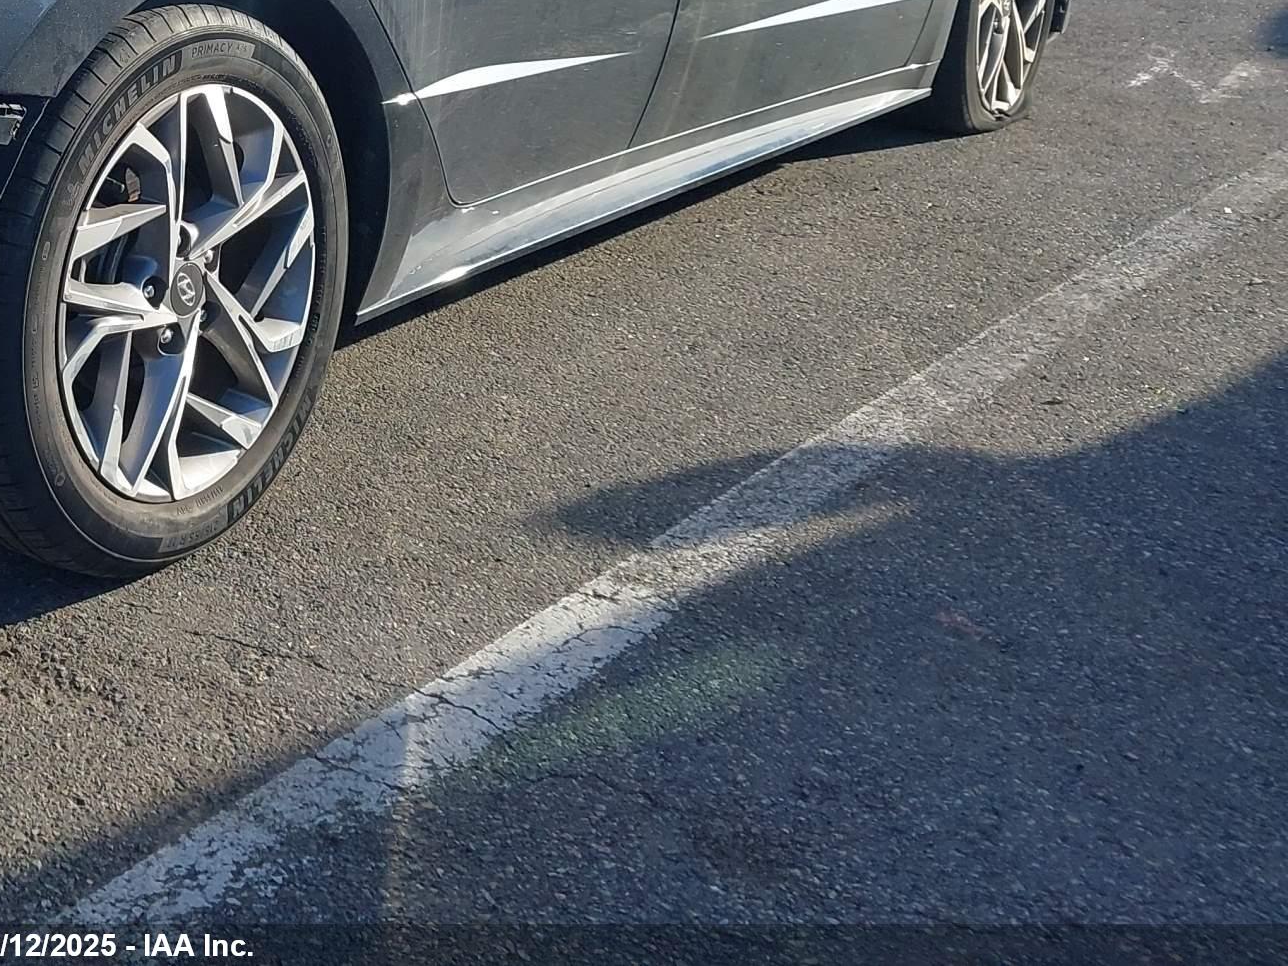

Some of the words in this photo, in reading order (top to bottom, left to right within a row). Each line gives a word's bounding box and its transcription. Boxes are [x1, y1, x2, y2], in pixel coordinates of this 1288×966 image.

[191, 43, 233, 58] PRIMACY
[77, 54, 177, 176] MICHELIN
[232, 393, 312, 520] MICHELIN
